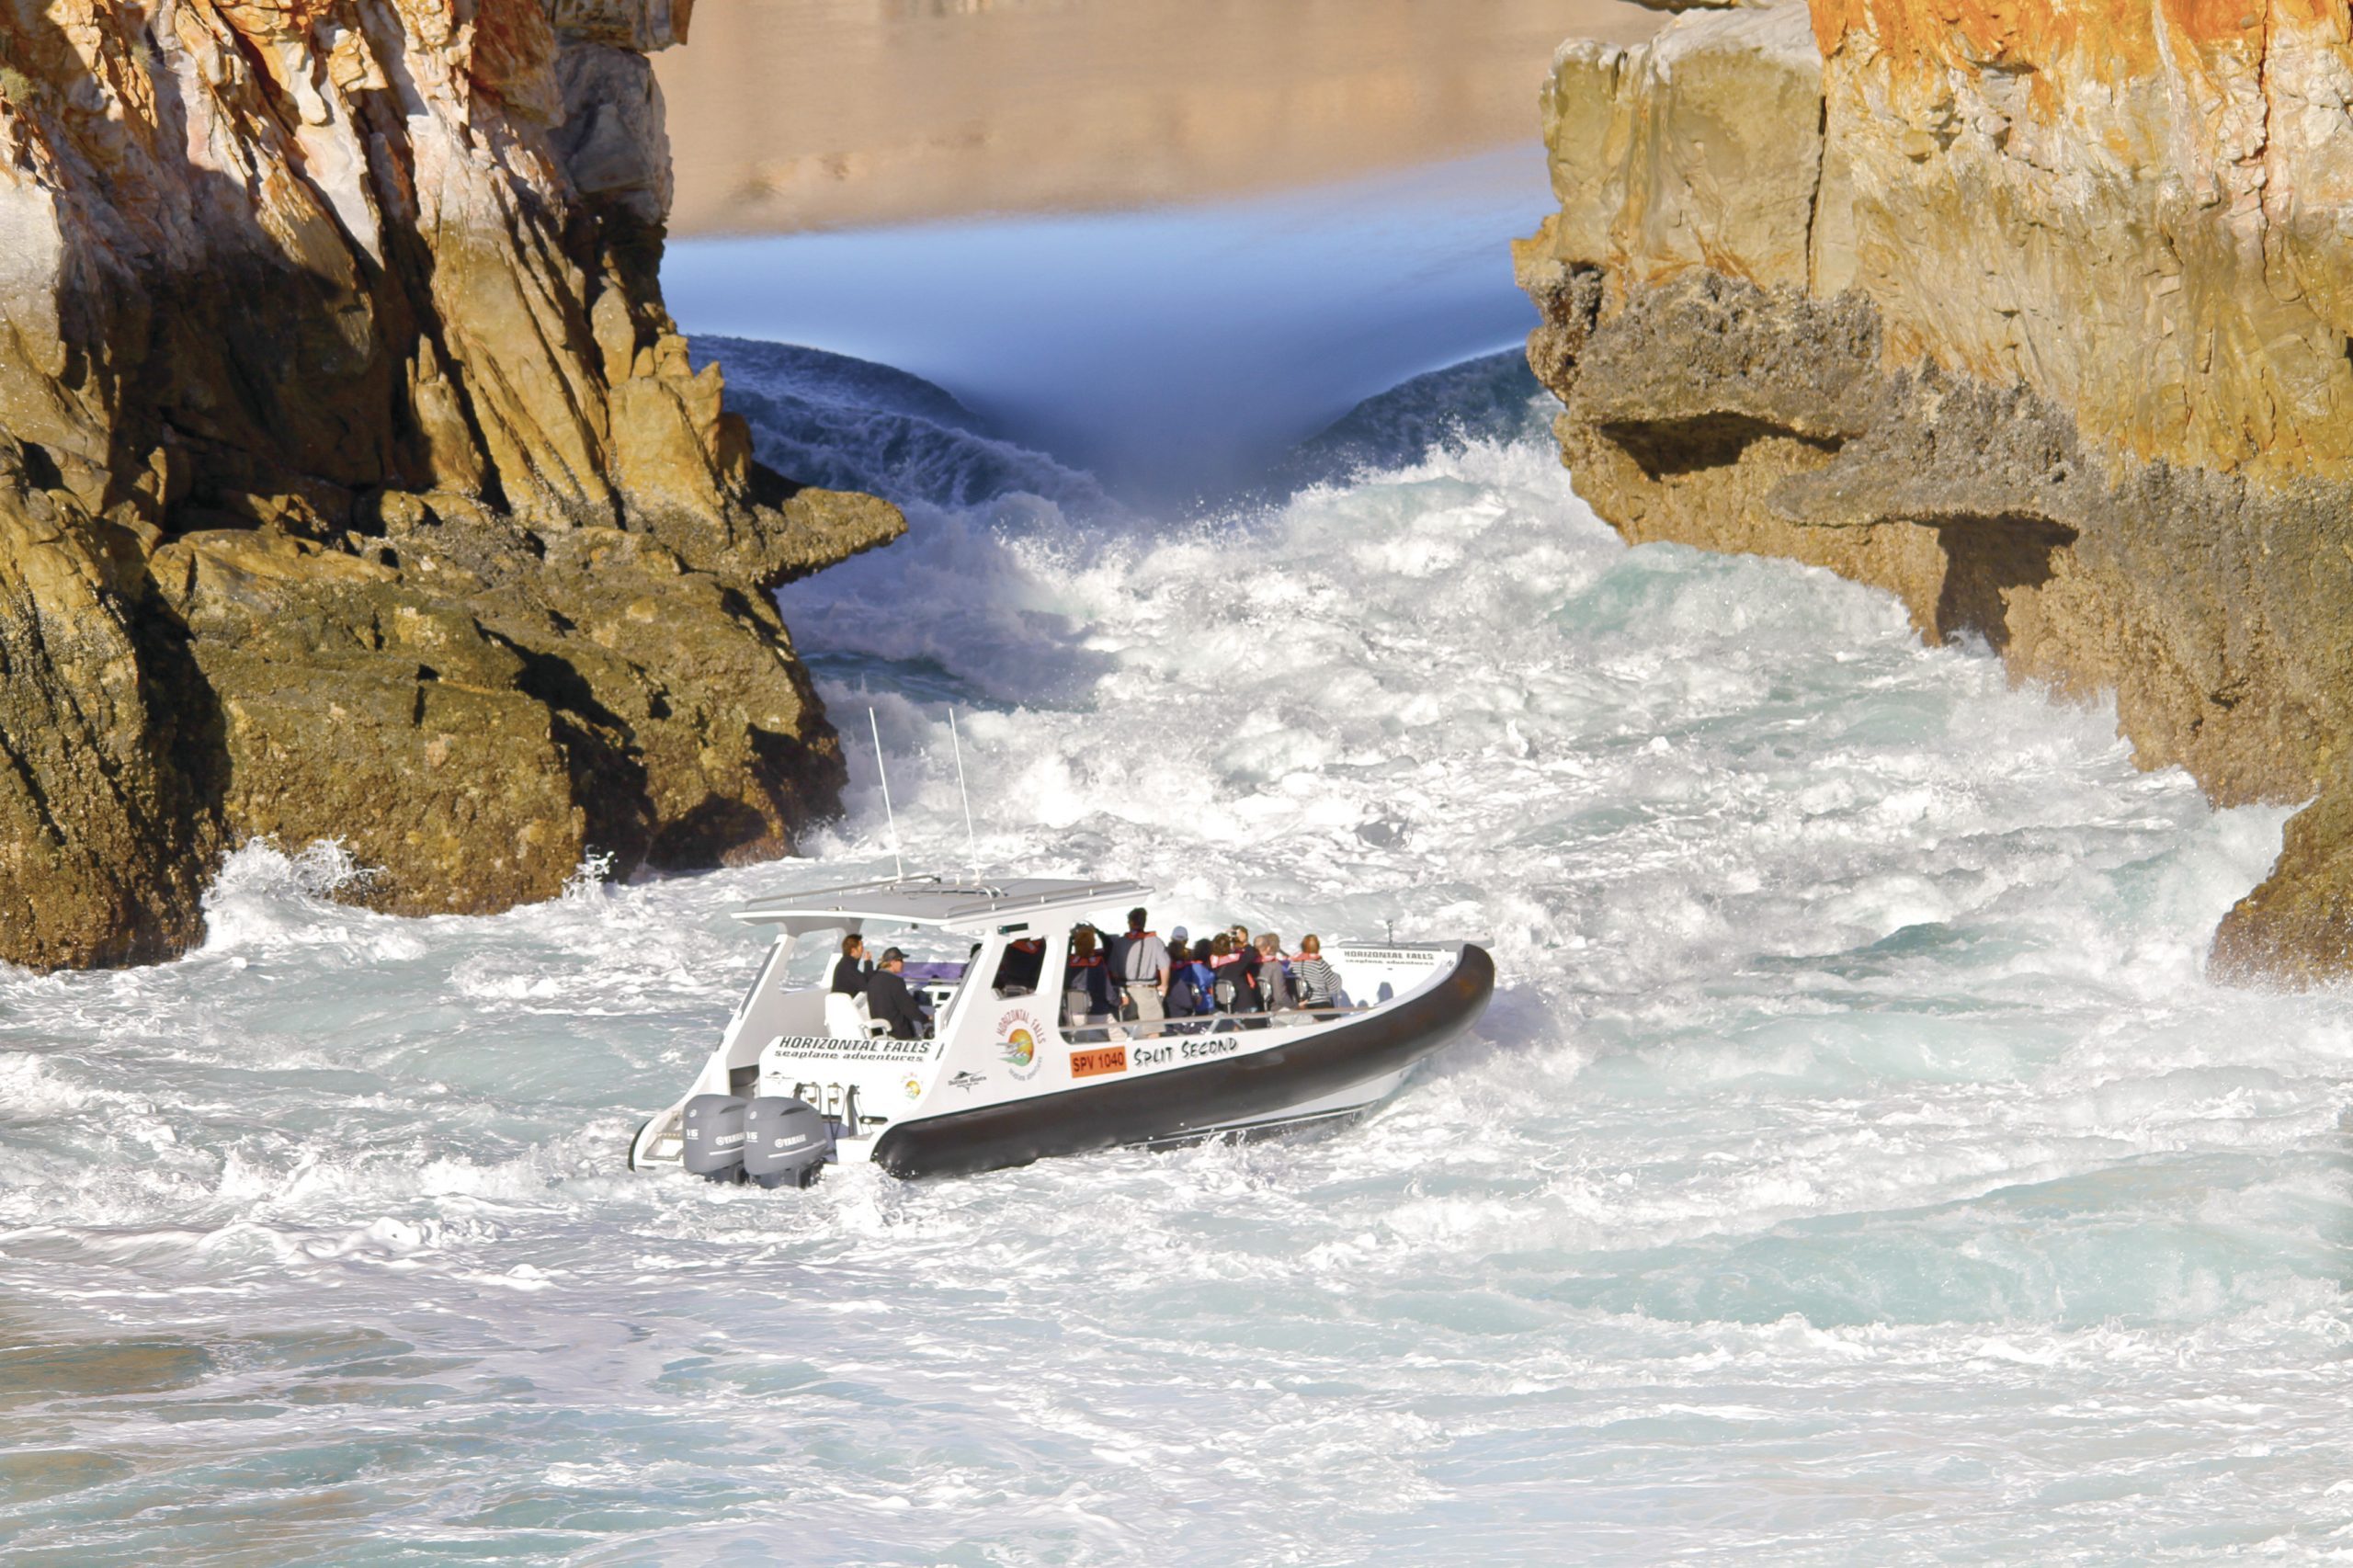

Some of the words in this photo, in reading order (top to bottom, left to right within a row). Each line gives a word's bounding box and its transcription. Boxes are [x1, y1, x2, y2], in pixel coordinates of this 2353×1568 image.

[779, 1036, 879, 1051] HORIZONTAL
[883, 1041, 931, 1054] FALLS
[1133, 1047, 1173, 1067] SPLIT
[1181, 1037, 1238, 1059] SECOND
[774, 1050, 838, 1060] seaplane
[843, 1052, 924, 1062] adventures
[1073, 1056, 1094, 1073] SPV
[1098, 1051, 1125, 1069] 1040
